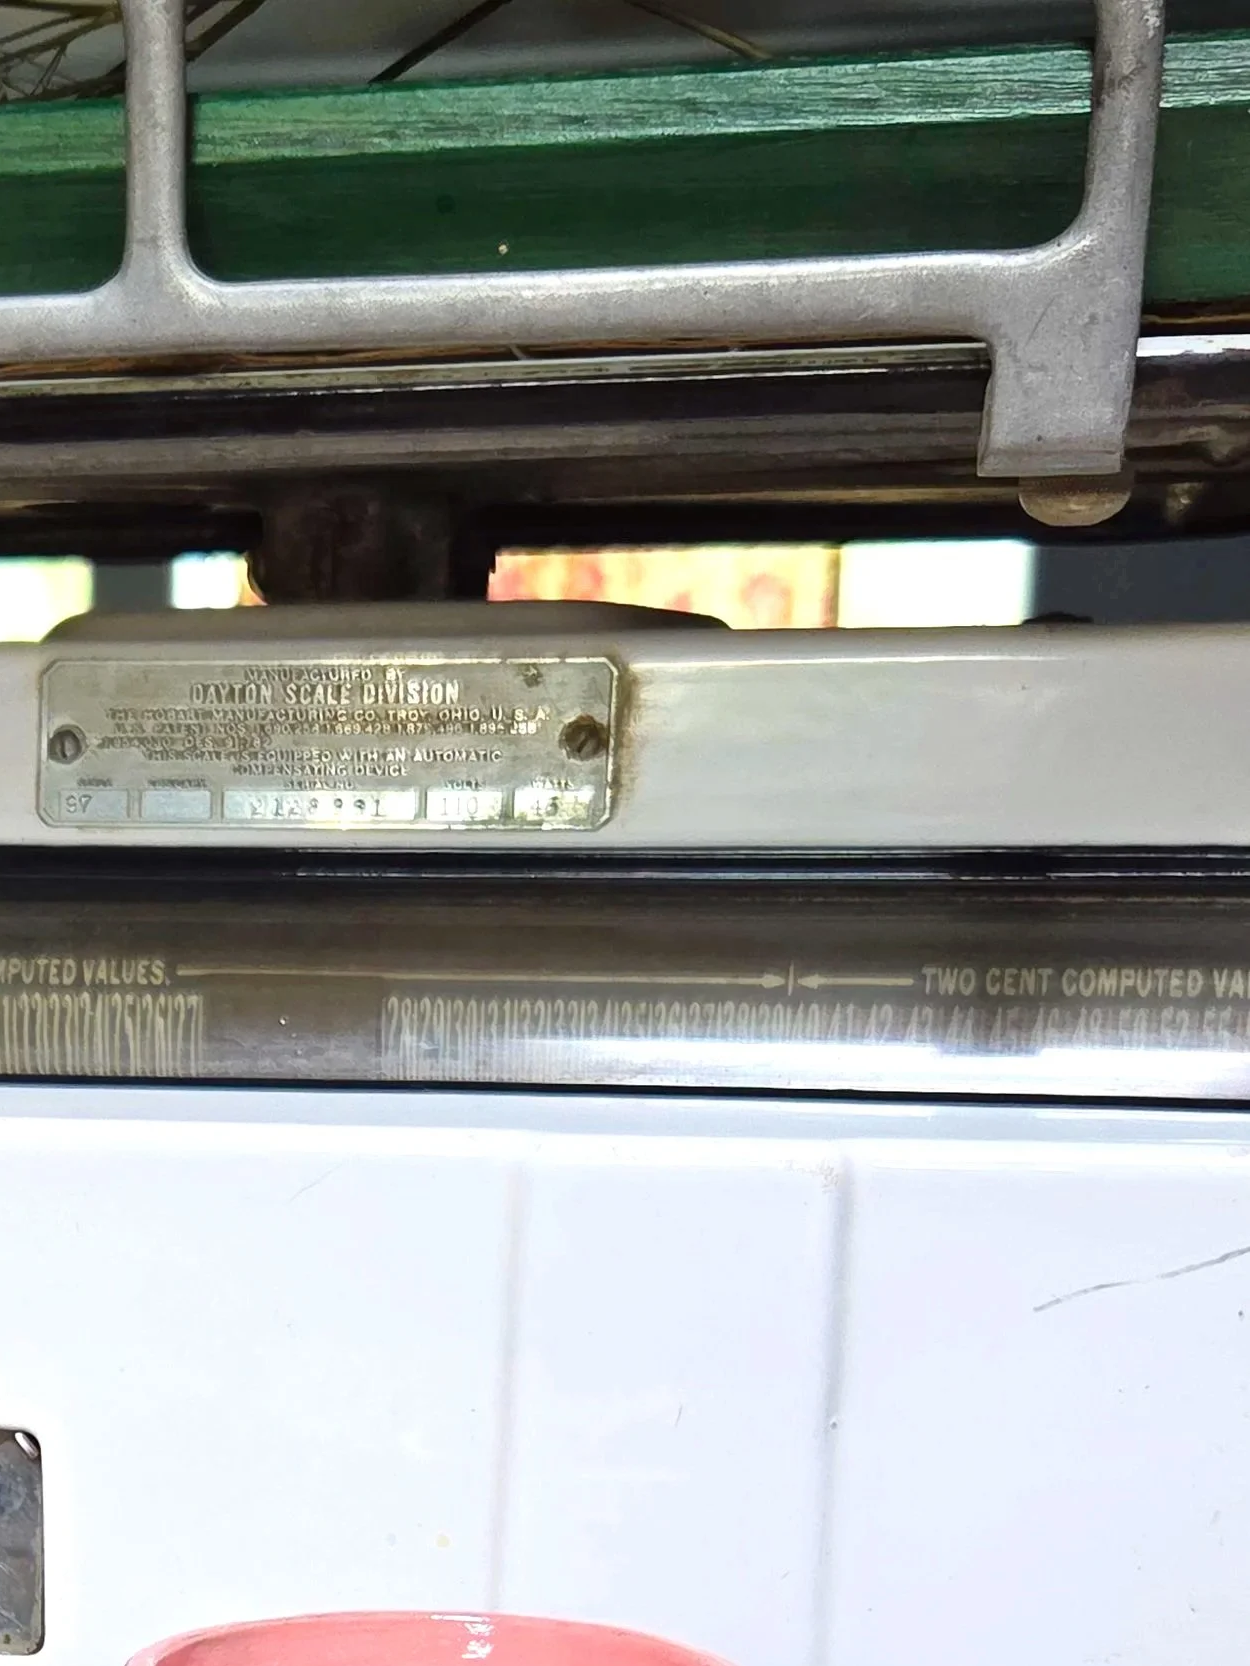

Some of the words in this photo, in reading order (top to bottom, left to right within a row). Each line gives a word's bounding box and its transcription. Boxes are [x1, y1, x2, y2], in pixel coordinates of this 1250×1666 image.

[192, 683, 271, 704] DAYTON
[285, 682, 351, 705] SCALE
[362, 679, 459, 705] DIVISION
[212, 709, 348, 722] MANUFACTURING
[257, 750, 332, 763] EQUIPPED
[385, 748, 408, 762] AN
[412, 749, 504, 763] AUTOMATIC
[921, 966, 977, 996] TWO
[985, 966, 1053, 996] CENT
[1061, 967, 1205, 998] COMPUTED
[1212, 967, 1250, 998] VA
